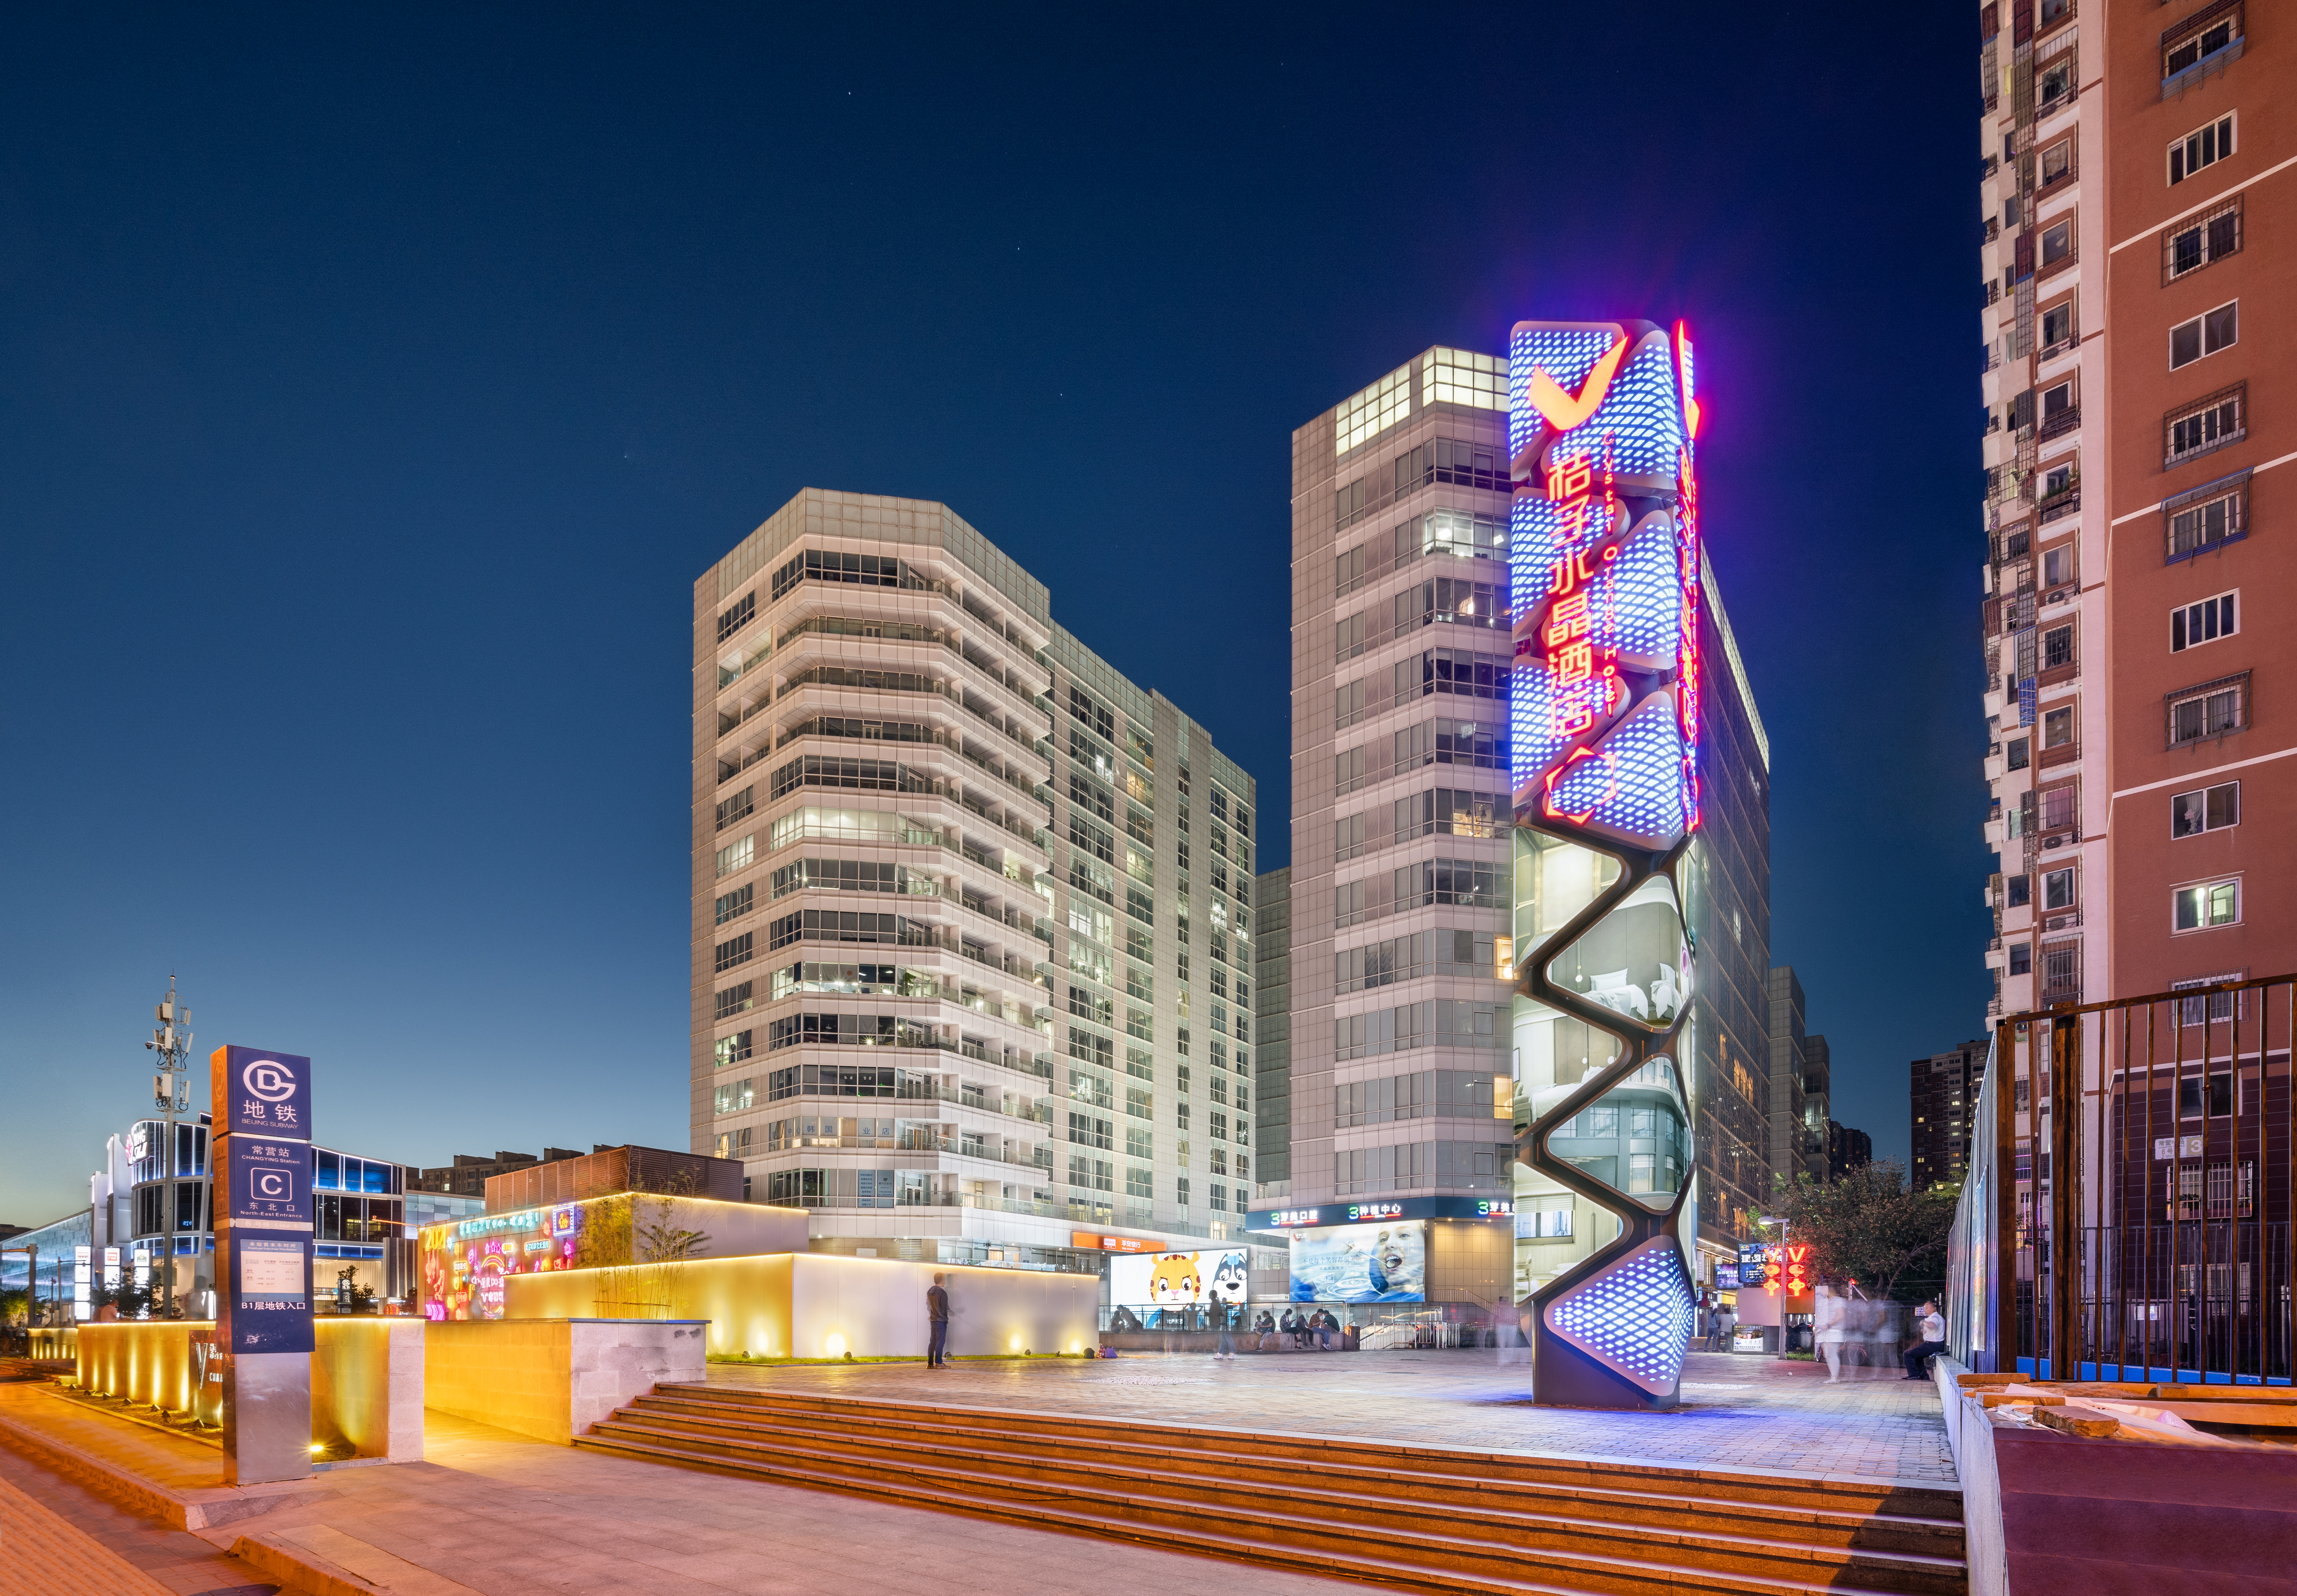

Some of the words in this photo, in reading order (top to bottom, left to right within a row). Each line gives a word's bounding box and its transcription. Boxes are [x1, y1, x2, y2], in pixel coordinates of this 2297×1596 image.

[1603, 431, 1615, 532] Crystal
[1548, 449, 1594, 740] 桔子水晶酒店
[1603, 546, 1618, 634] Orange
[1603, 645, 1617, 715] Hotel
[243, 1100, 297, 1123] 地铁
[134, 1129, 145, 1146] BHG
[252, 1145, 290, 1157] 常营站
[2191, 1139, 2202, 1153] 3
[261, 1174, 282, 1195] C
[249, 1202, 295, 1212] 东北口
[1360, 1203, 1401, 1216] 种植中心
[1489, 1202, 1515, 1212] 芽美
[1122, 1240, 1141, 1248] 平安银行
[1302, 1256, 1362, 1264] 不是每个笑容都很美丽
[242, 1302, 305, 1310] B1层地铁入口
